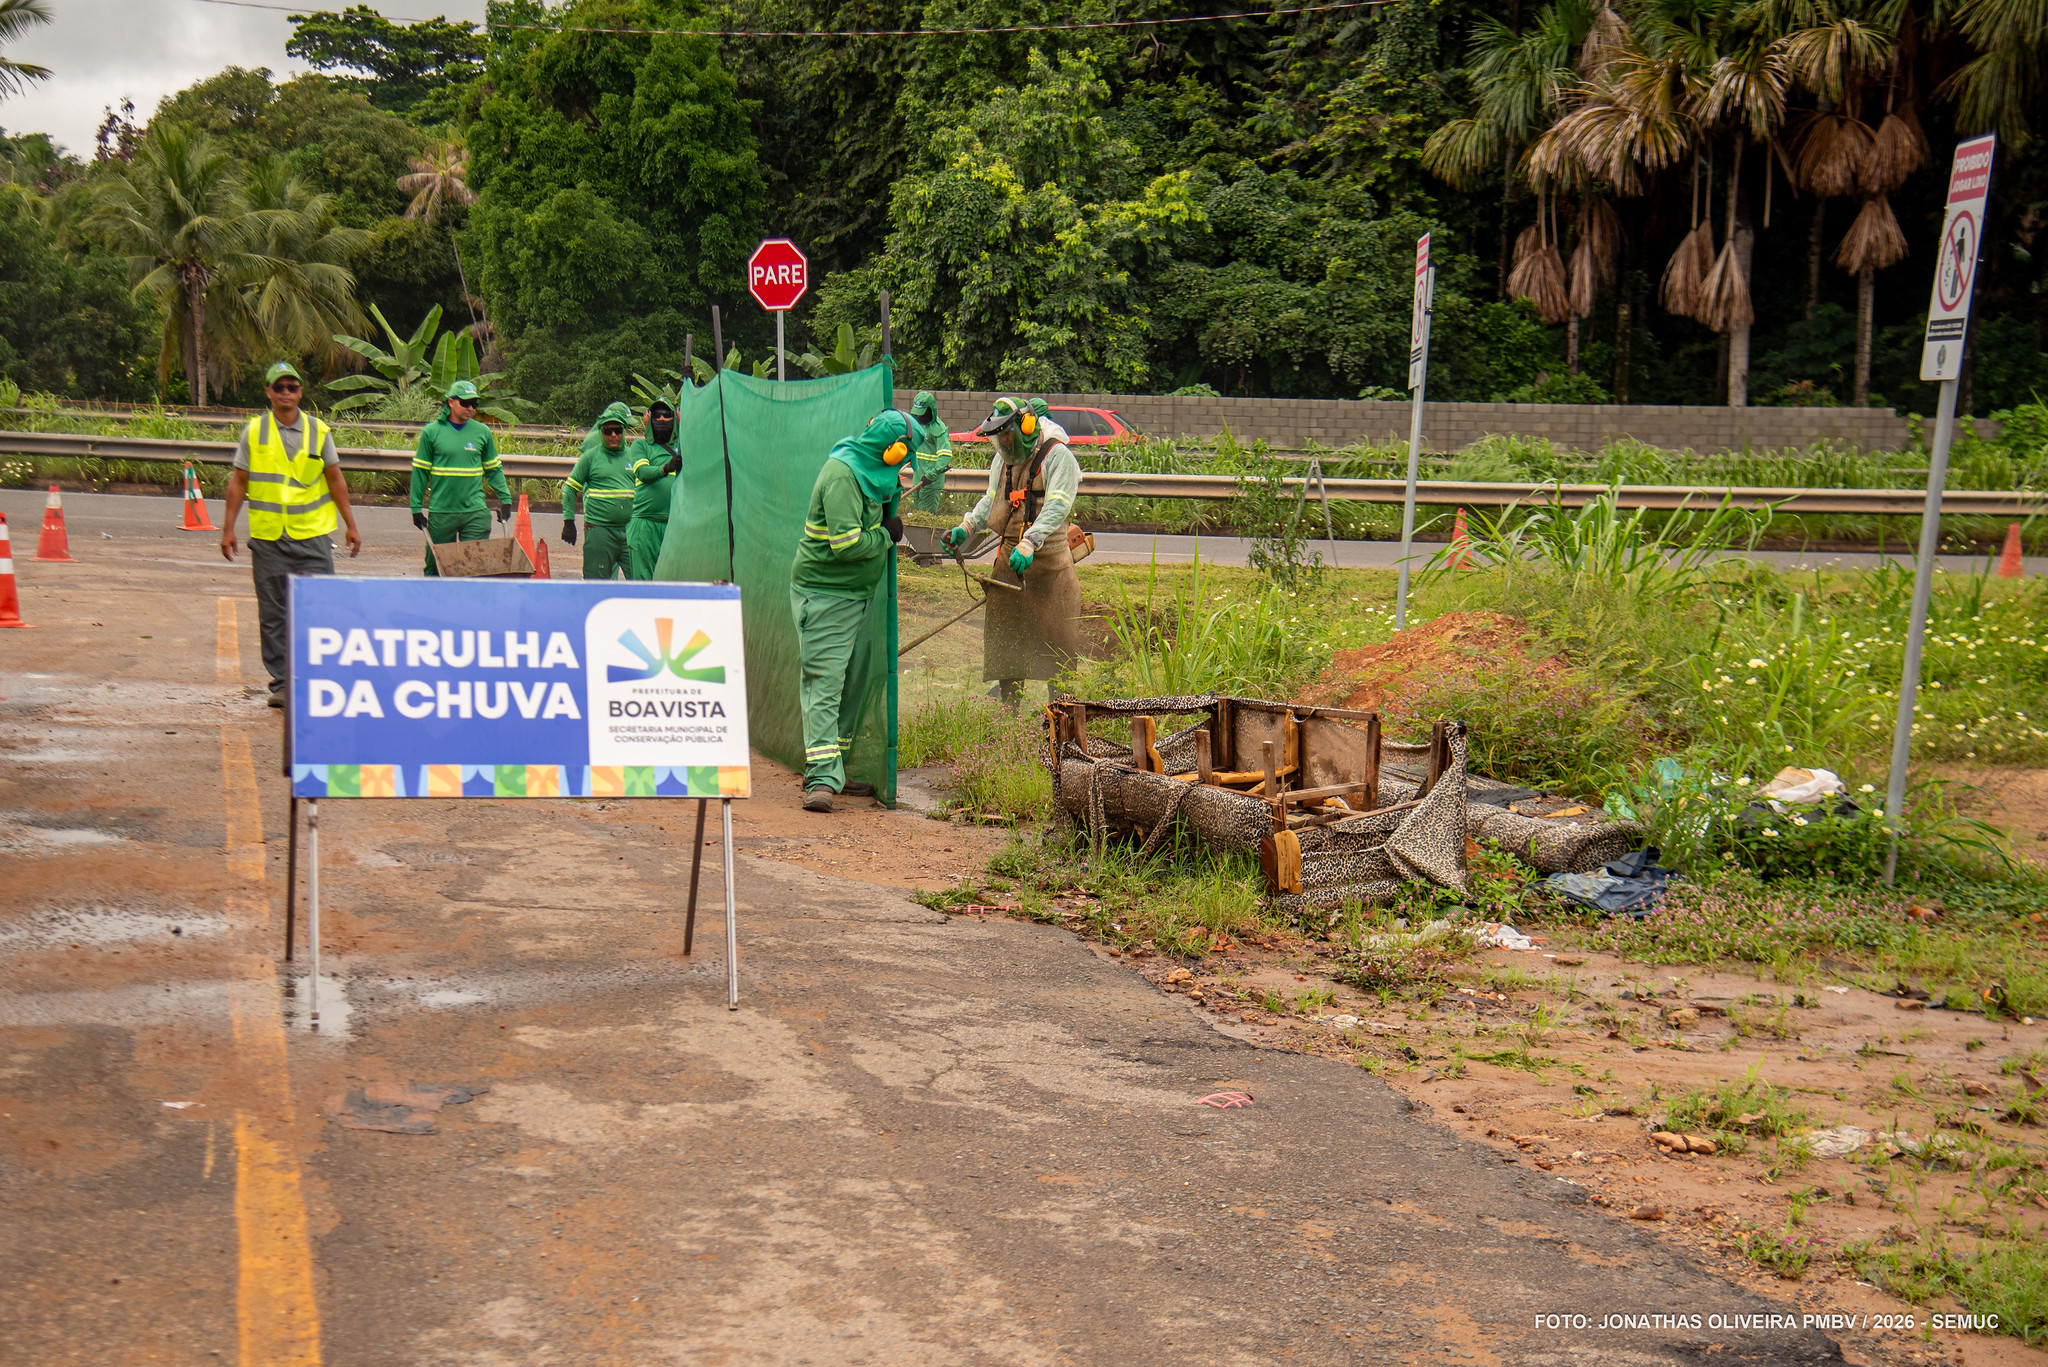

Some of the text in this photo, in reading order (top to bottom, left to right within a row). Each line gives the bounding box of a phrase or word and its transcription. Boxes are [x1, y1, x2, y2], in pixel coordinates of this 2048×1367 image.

[1956, 151, 1989, 173] PROIBIDO
[753, 264, 803, 285] PARE
[308, 627, 580, 669] PATRULHA
[308, 679, 582, 719] DA CHUVA
[608, 725, 663, 733] SECRETARIA
[665, 725, 714, 733] MUNICIPAL
[614, 733, 723, 744] CONSERVAÇÃO PÚBLICA
